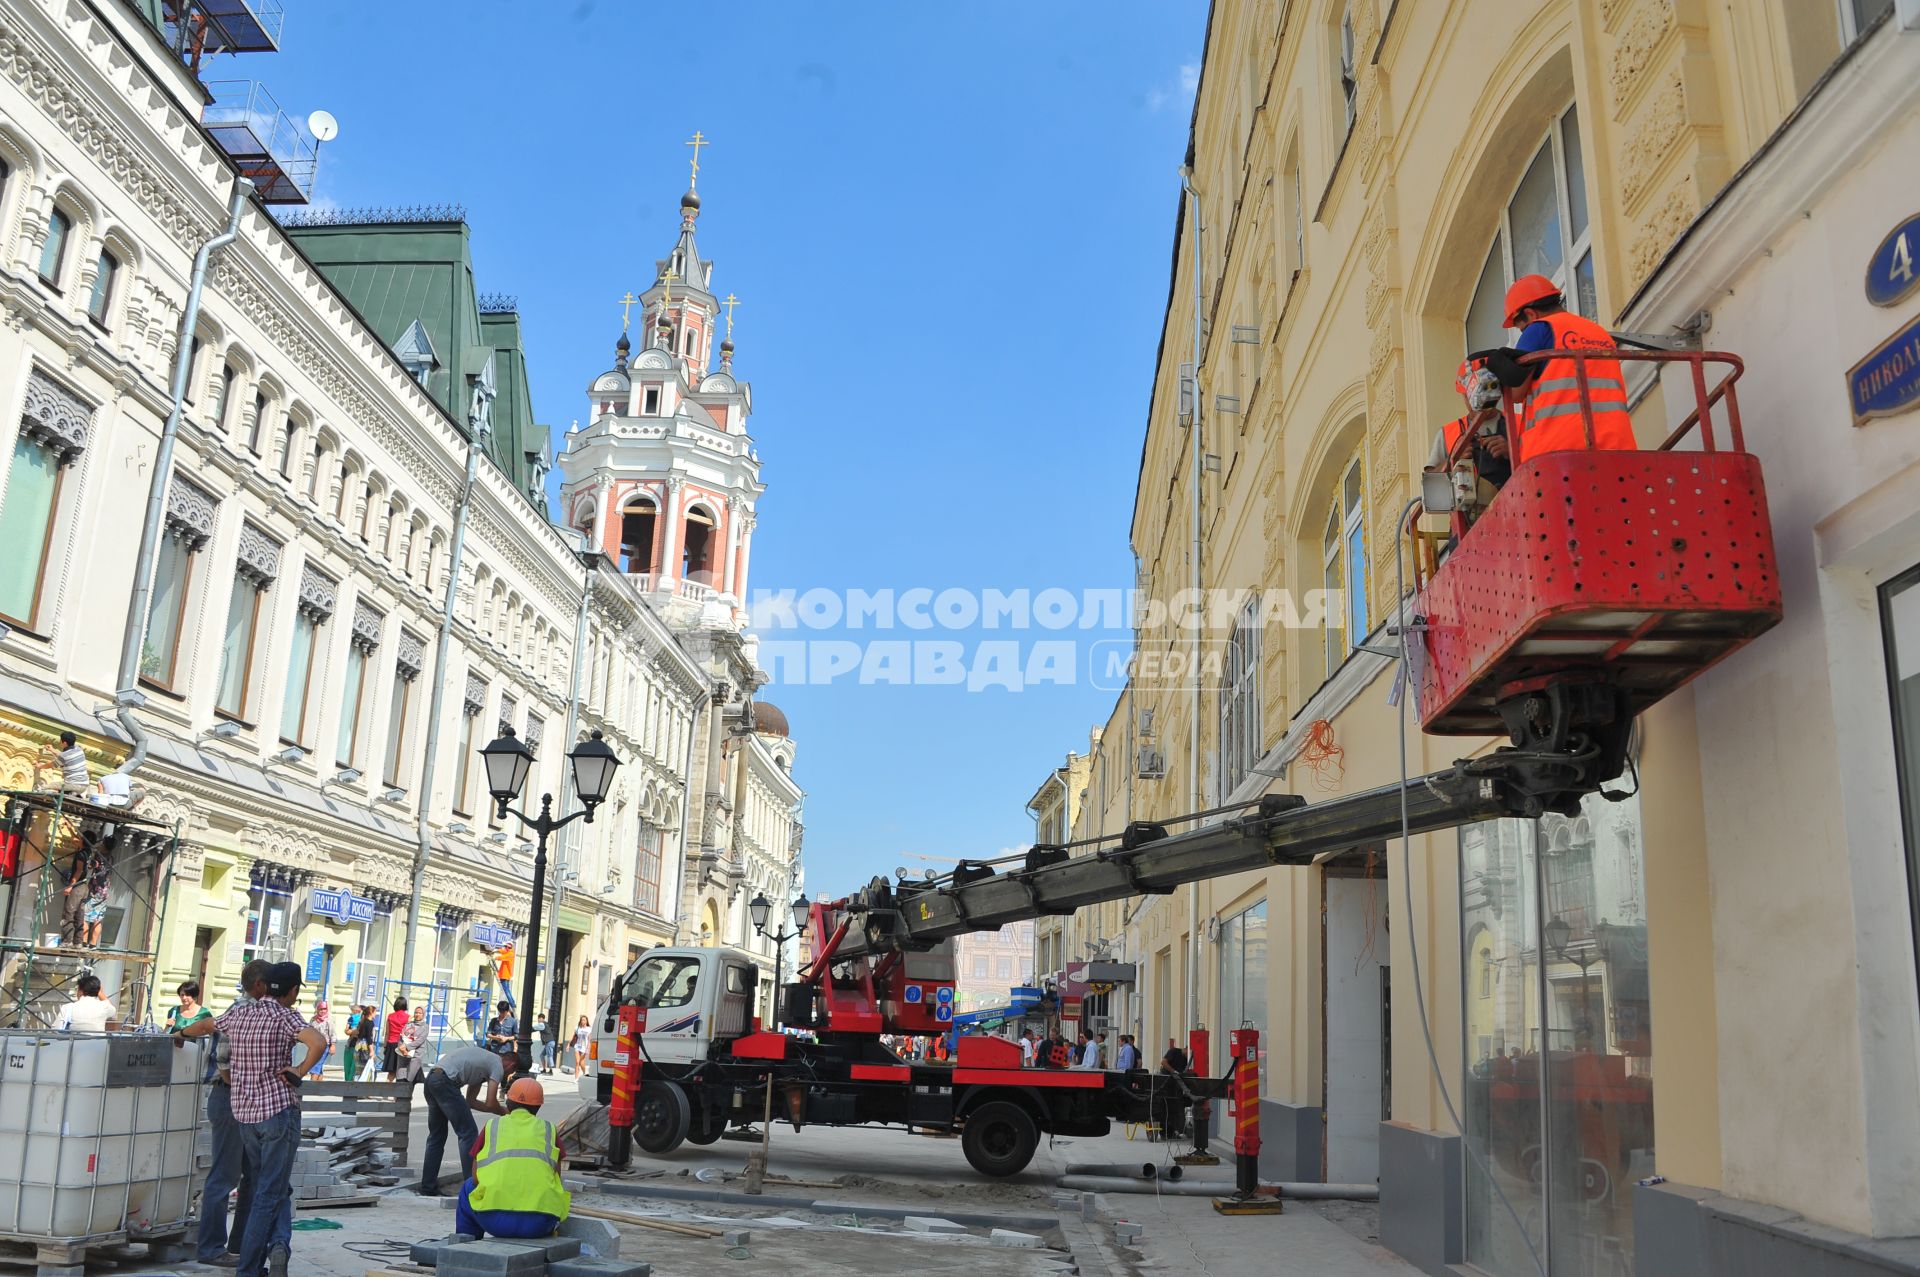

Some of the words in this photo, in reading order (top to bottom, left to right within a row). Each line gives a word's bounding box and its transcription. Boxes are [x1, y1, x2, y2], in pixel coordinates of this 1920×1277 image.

[1889, 232, 1913, 282] 4
[314, 893, 339, 911] ПОЧТА
[351, 902, 372, 918] РОССИИ
